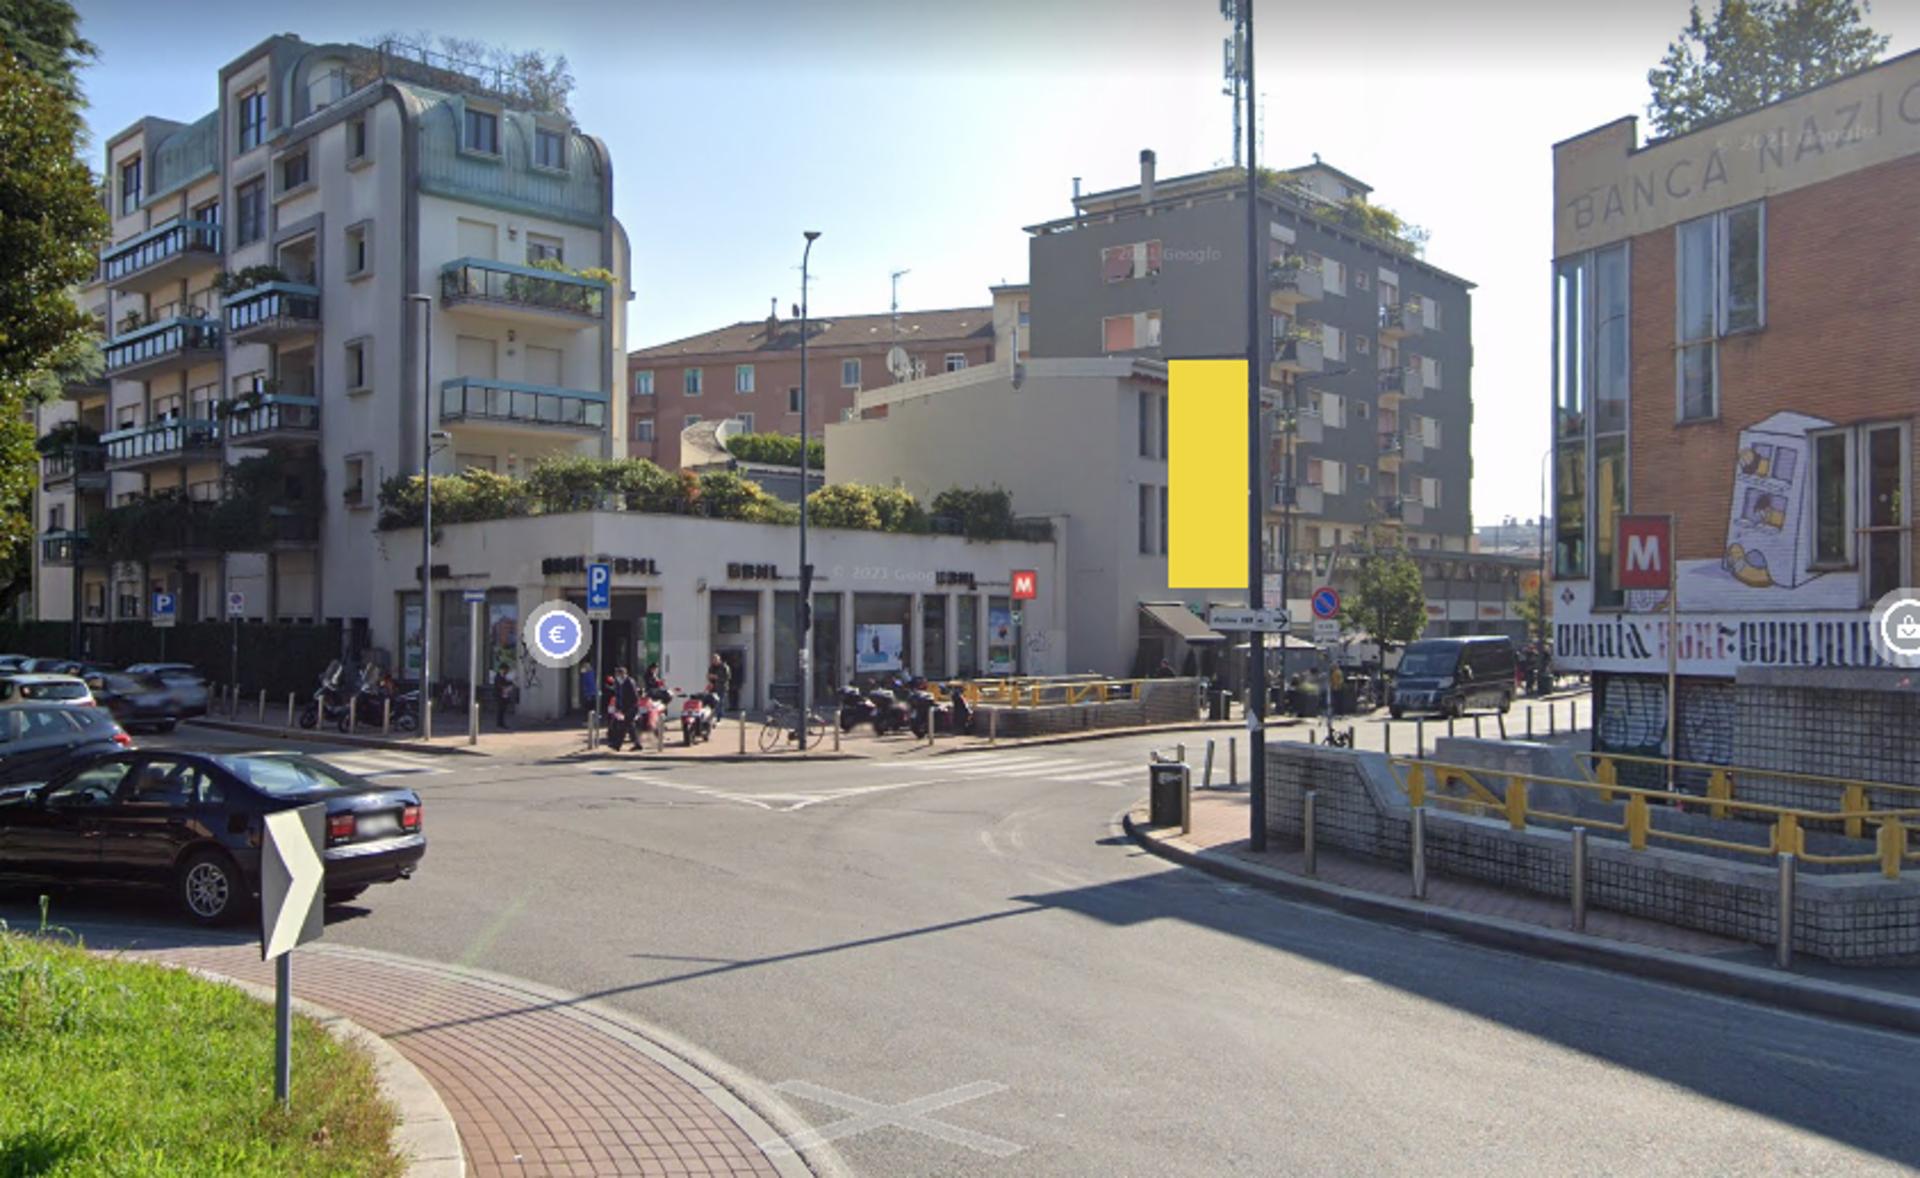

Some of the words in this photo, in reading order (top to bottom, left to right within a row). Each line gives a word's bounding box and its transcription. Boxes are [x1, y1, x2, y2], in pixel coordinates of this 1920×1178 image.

[1567, 151, 1728, 230] BANCA
[1626, 534, 1662, 572] M
[592, 566, 607, 592] P
[1015, 576, 1032, 593] M
[157, 594, 171, 612] P
